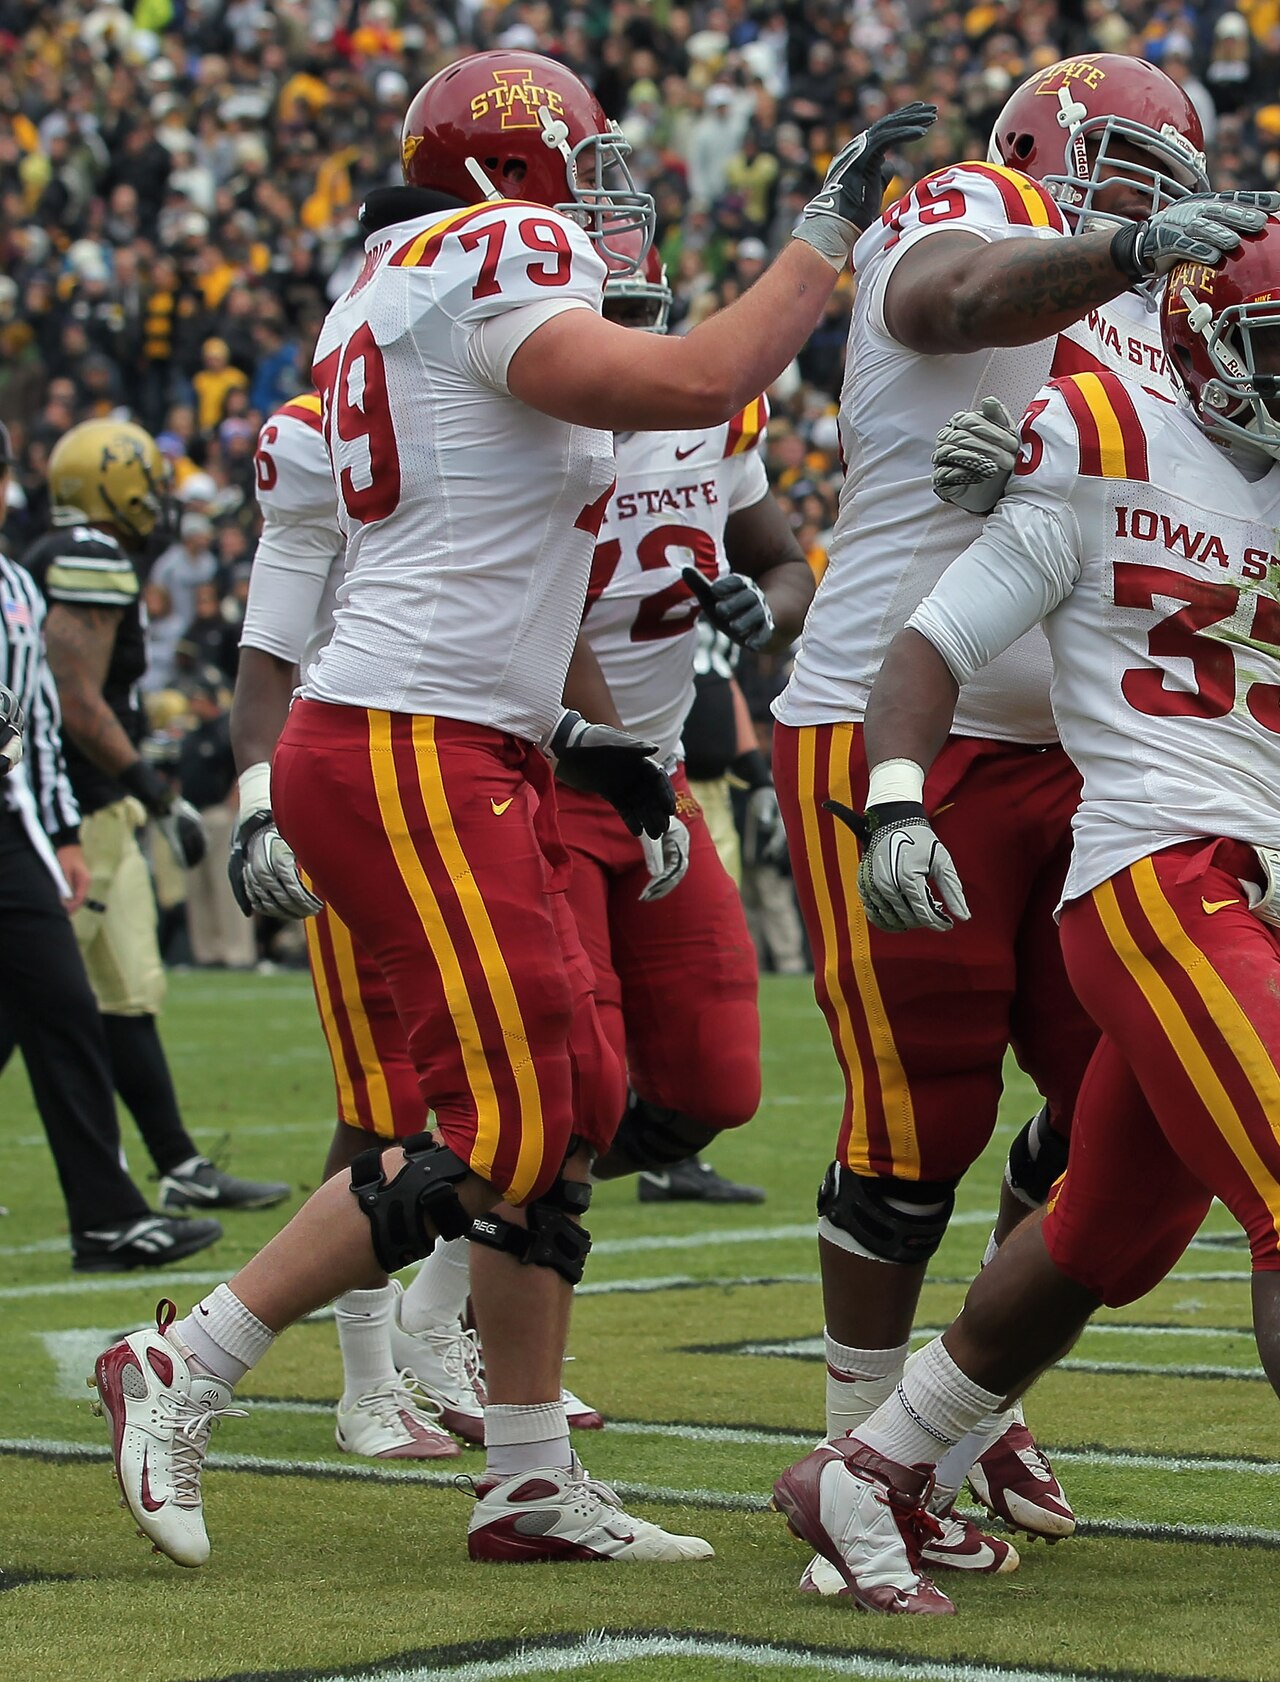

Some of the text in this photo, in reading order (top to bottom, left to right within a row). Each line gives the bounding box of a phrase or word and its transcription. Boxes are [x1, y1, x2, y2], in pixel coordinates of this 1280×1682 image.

[470, 85, 565, 121] STATE
[458, 217, 573, 300] 79
[1254, 293, 1272, 303] NIKE
[616, 480, 719, 520] STATE
[1115, 505, 1229, 568] IOWA
